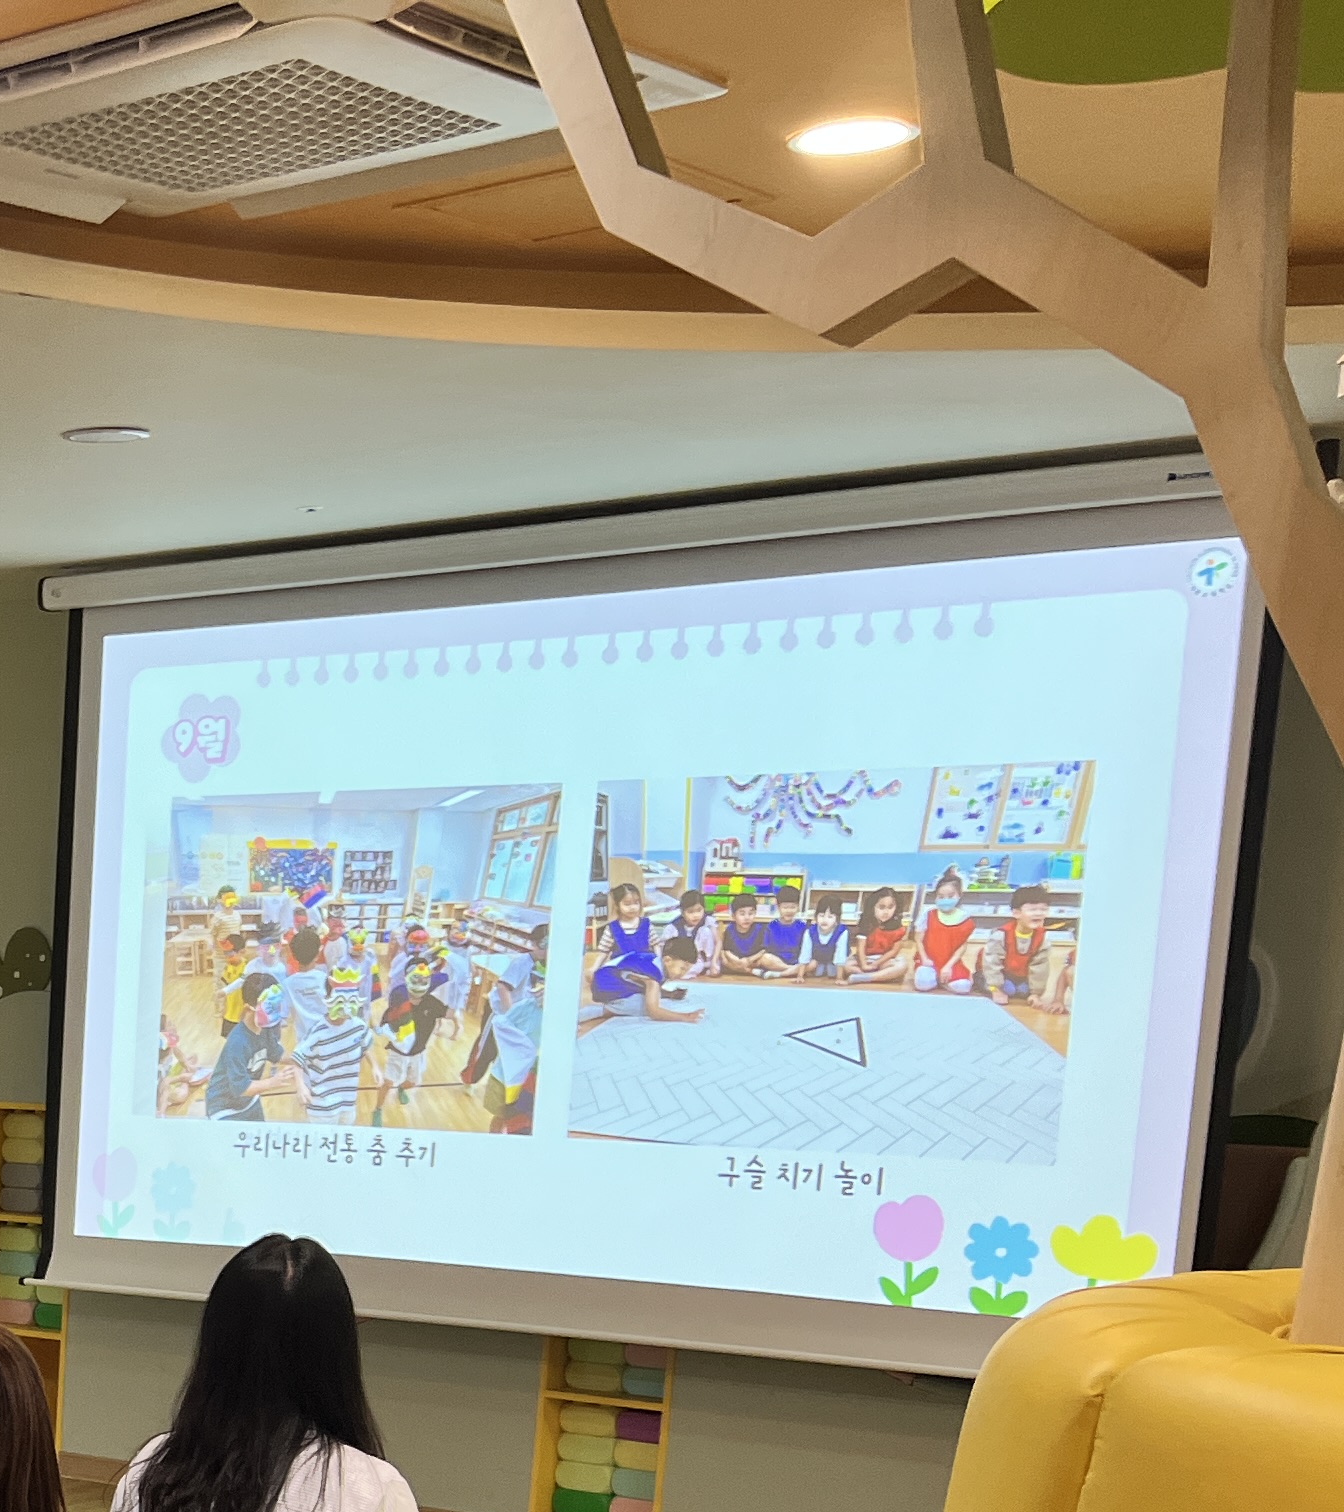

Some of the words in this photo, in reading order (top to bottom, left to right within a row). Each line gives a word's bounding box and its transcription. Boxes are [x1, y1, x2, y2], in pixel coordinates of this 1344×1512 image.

[173, 715, 230, 764] 9월
[233, 1131, 312, 1159] 우리나라
[319, 1132, 358, 1164] 전통
[366, 1134, 387, 1167] 춤
[395, 1137, 436, 1168] 추기
[717, 1154, 766, 1190] 구슬
[777, 1161, 824, 1192] 치기
[834, 1160, 884, 1196] 놀이
